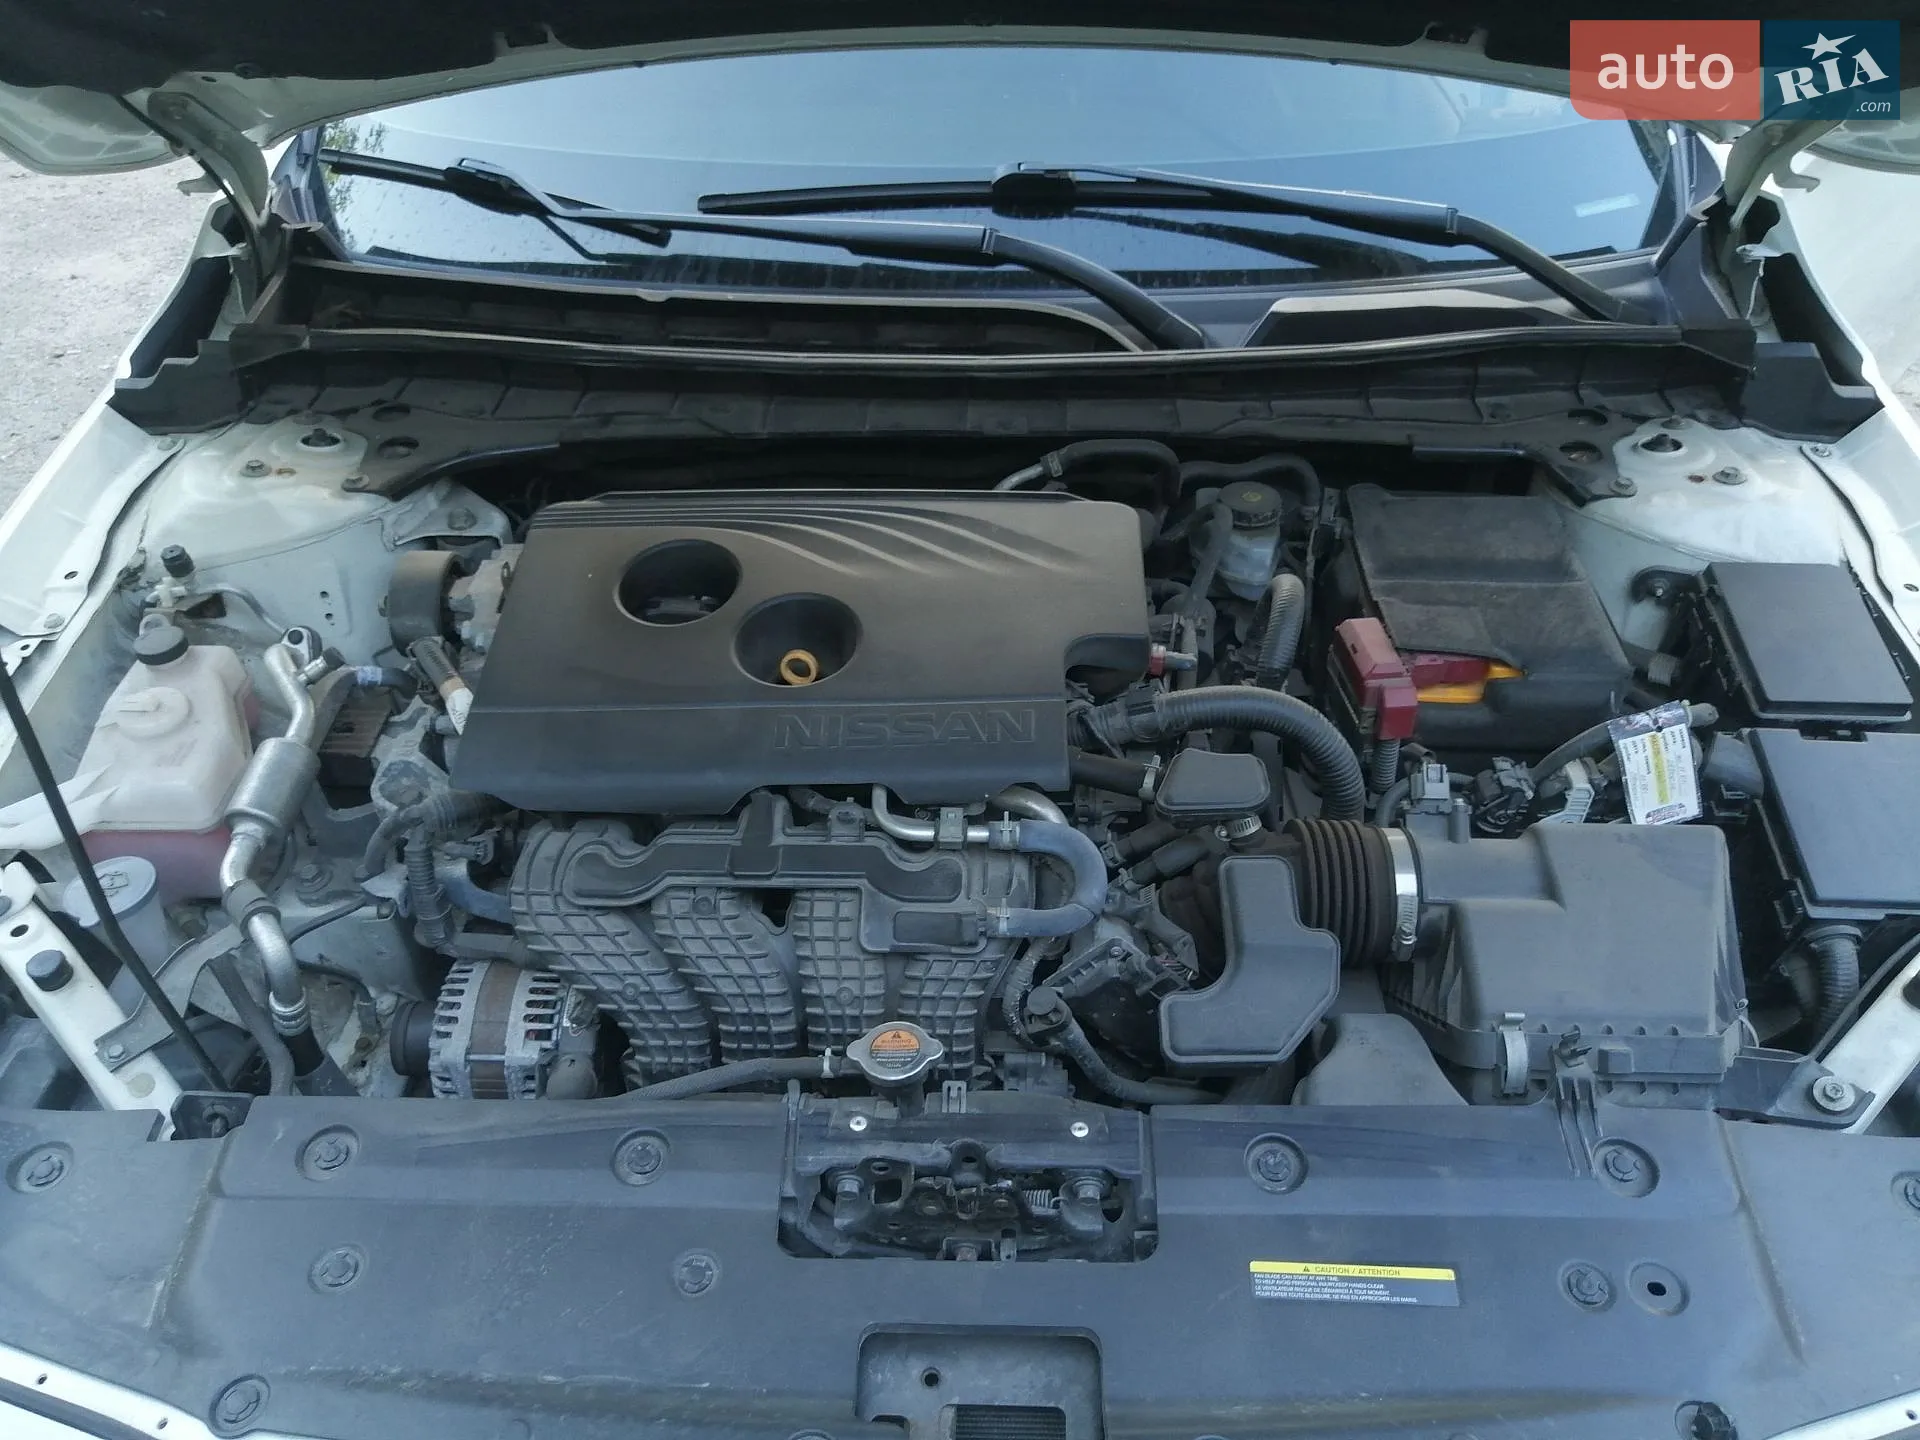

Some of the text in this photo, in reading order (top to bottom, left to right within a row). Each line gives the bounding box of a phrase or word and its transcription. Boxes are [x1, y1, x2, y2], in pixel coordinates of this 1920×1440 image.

[774, 710, 1035, 749] NISSAN
[1315, 1266, 1350, 1274] CAUTION
[1358, 1268, 1401, 1276] ATTENTION
